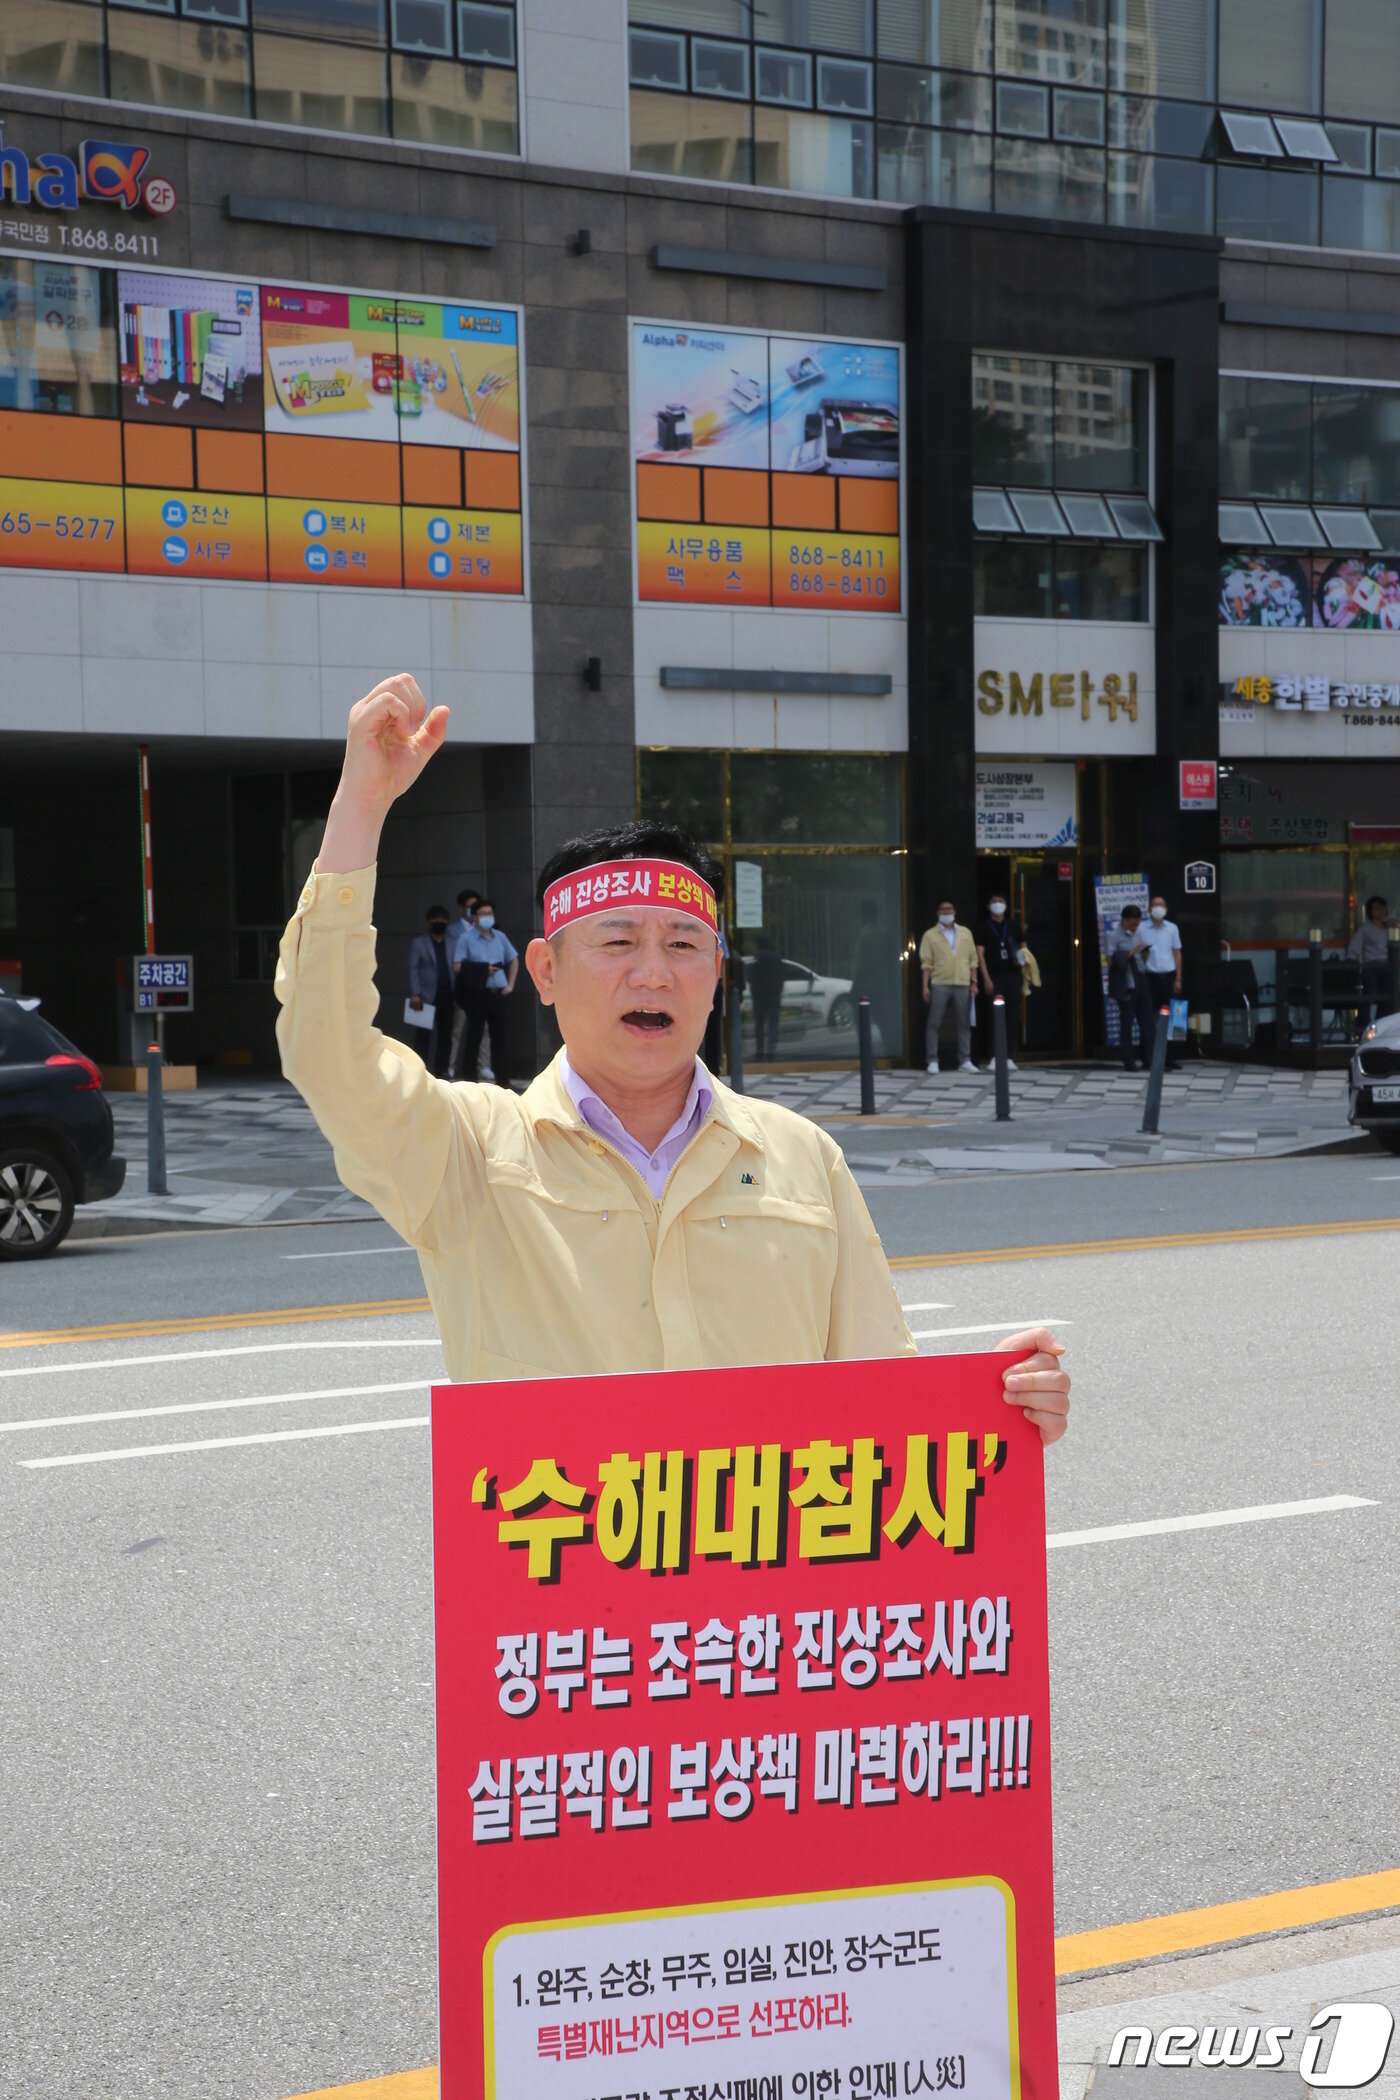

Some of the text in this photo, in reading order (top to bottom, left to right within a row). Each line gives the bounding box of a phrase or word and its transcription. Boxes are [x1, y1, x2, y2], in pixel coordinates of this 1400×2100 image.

[150, 187, 171, 205] 2F
[58, 225, 158, 256] T.868.8411
[1, 511, 115, 541] 65-5277
[667, 537, 885, 568] 사무용품 868-8411
[789, 573, 887, 596] 868-8410
[977, 670, 1138, 722] SM타워
[550, 887, 572, 922] 수해
[576, 871, 652, 908] 진상조사
[658, 872, 703, 911] 보상책
[140, 963, 187, 985] 주차공간
[495, 1597, 1012, 1717] 정부는 조속한 진상조사와
[468, 1715, 1031, 1843] 실질적인 보상책 마련하라!!!
[513, 1928, 942, 2007] 1. 완주, 순창, 무주, 임실, 진안, 장수군도
[538, 1992, 852, 2062] 특별재난지역으로 선포하라.
